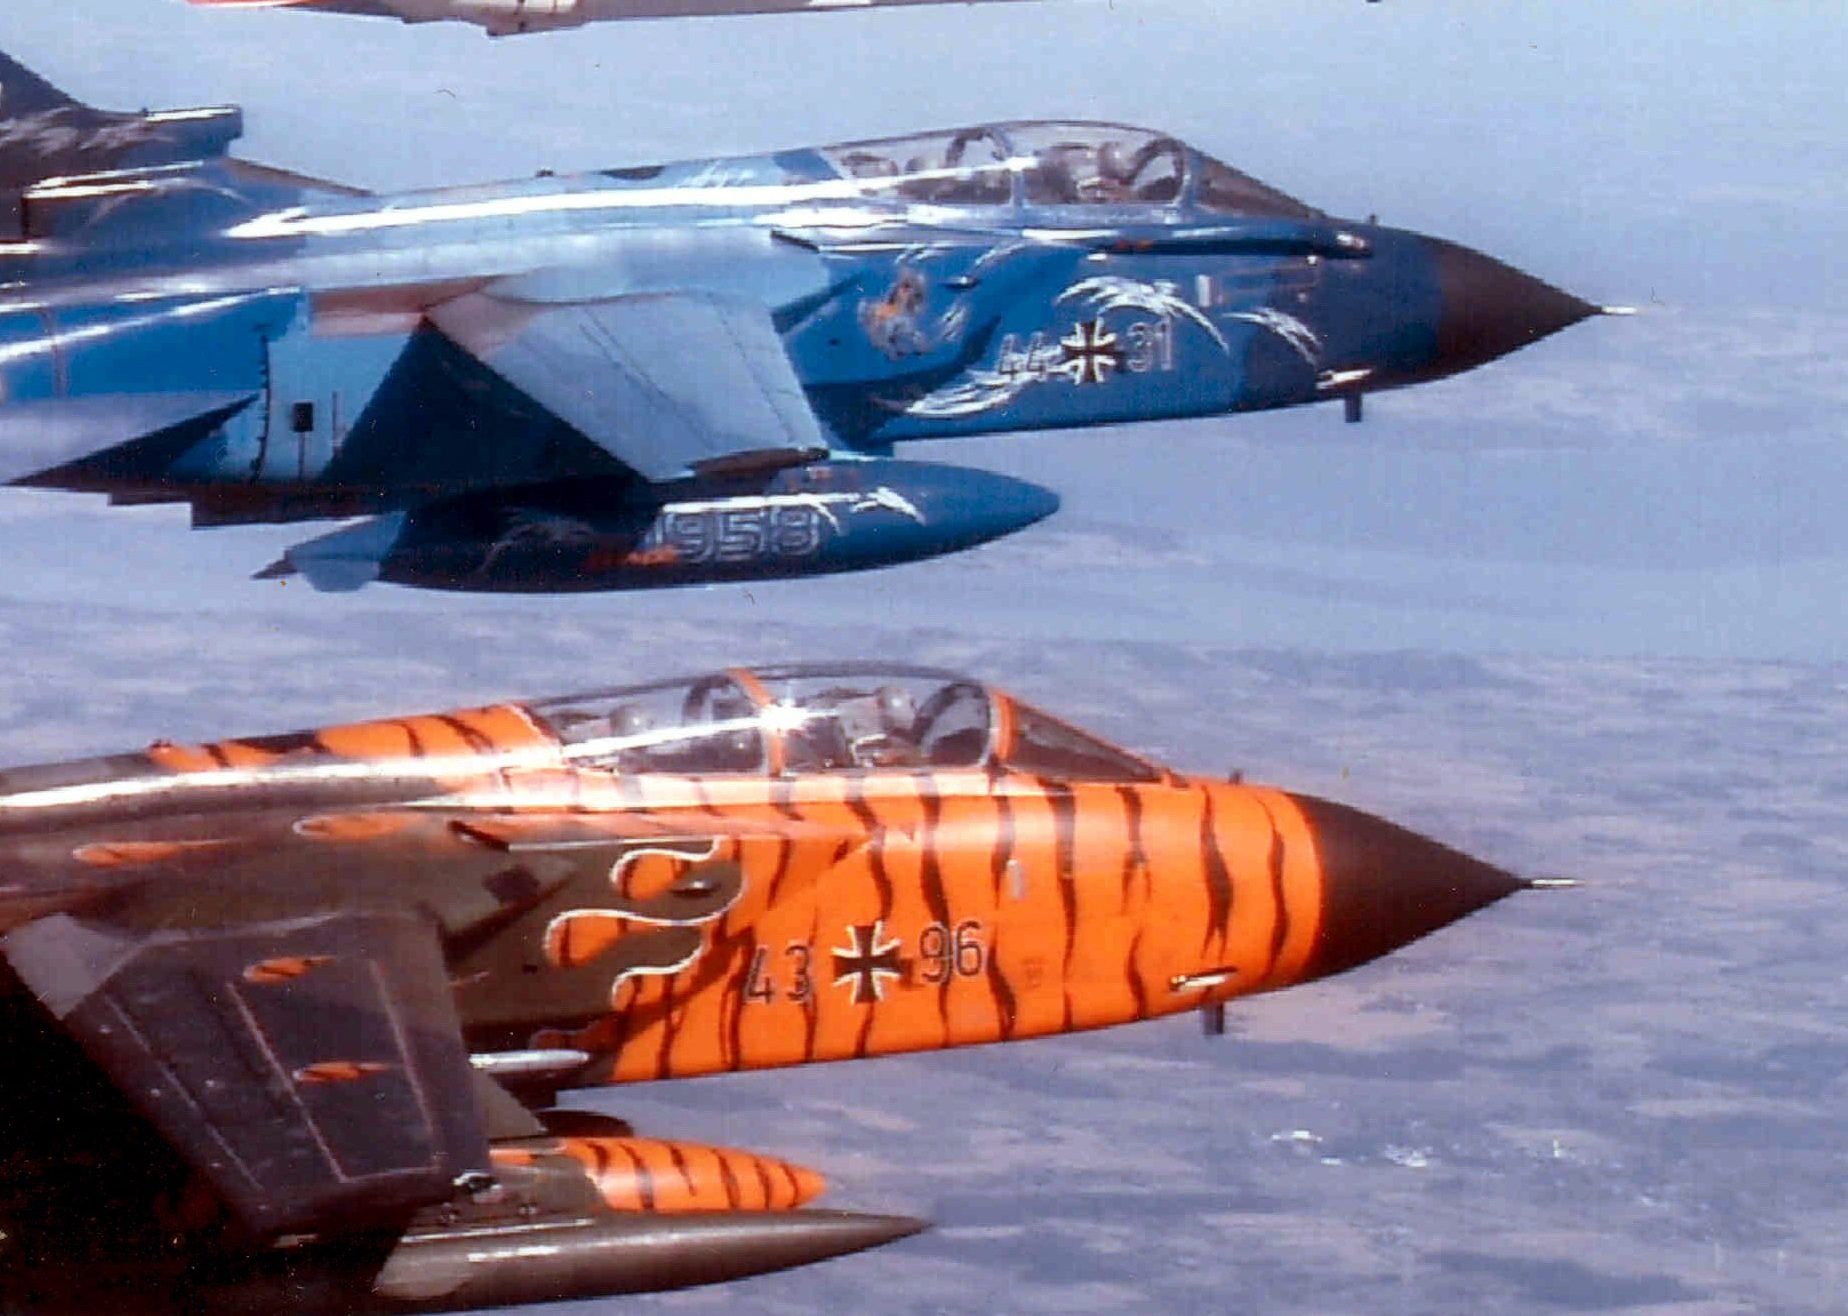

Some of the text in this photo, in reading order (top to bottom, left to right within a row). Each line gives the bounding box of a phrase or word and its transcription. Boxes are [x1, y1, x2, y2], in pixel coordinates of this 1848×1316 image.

[1126, 316, 1172, 373] 31
[745, 941, 812, 1005] 43
[918, 921, 983, 984] 96
